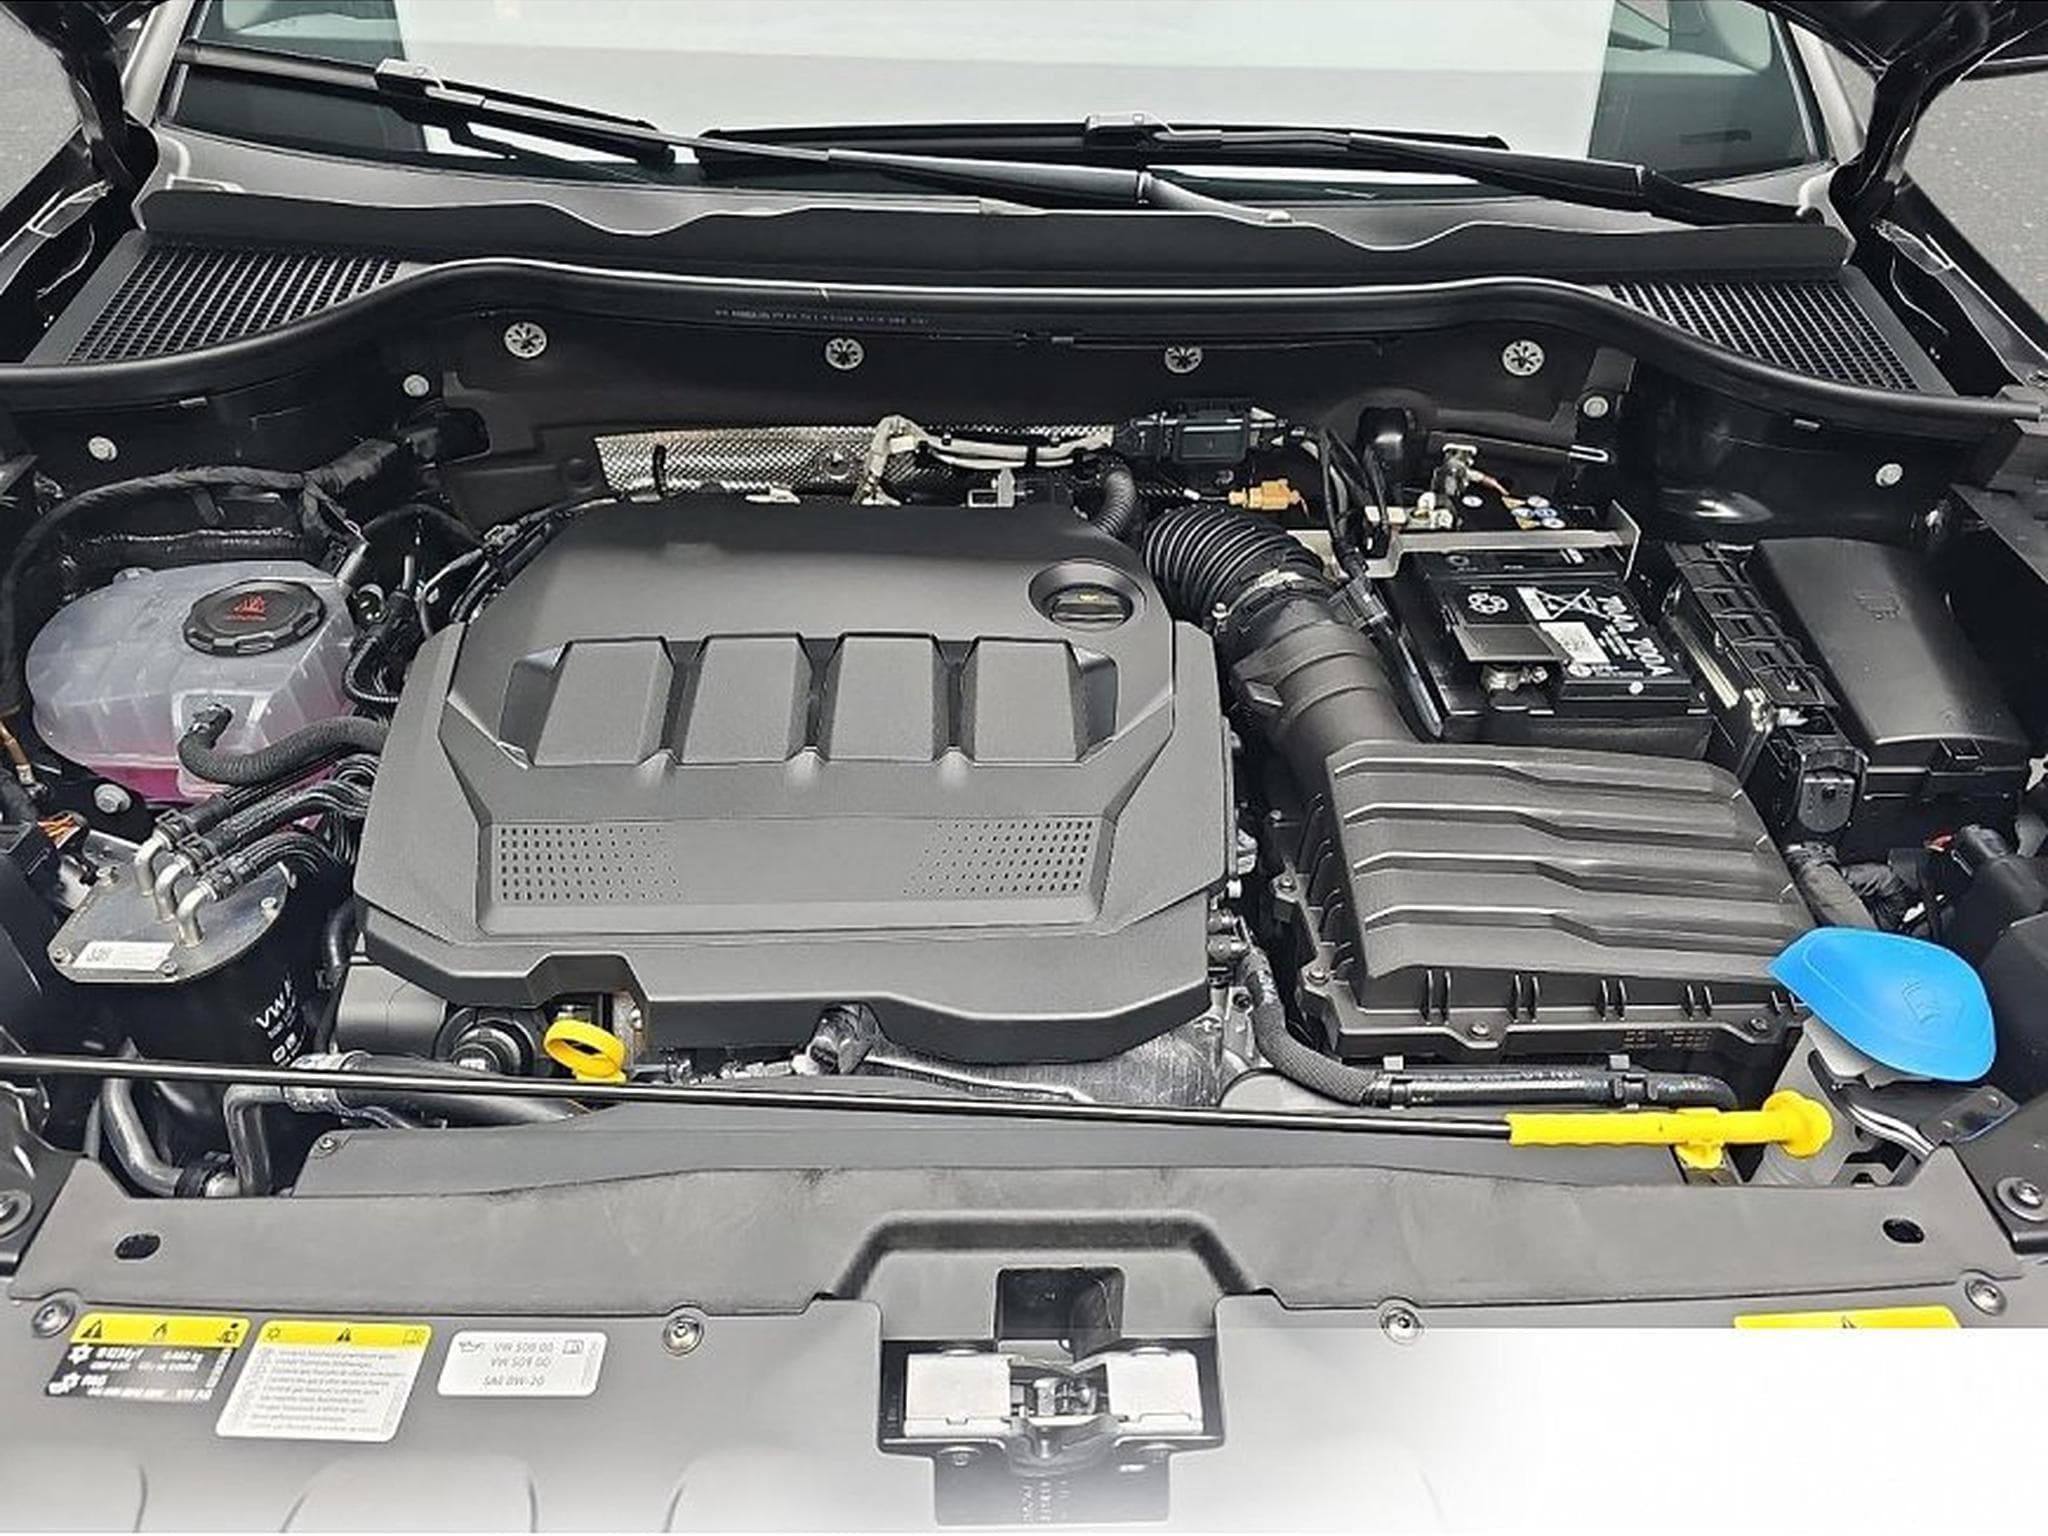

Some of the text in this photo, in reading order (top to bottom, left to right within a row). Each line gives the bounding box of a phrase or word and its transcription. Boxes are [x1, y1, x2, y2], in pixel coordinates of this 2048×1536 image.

[1626, 637, 1674, 677] 700A
[493, 1341, 513, 1353] VW
[490, 1355, 508, 1367] VW
